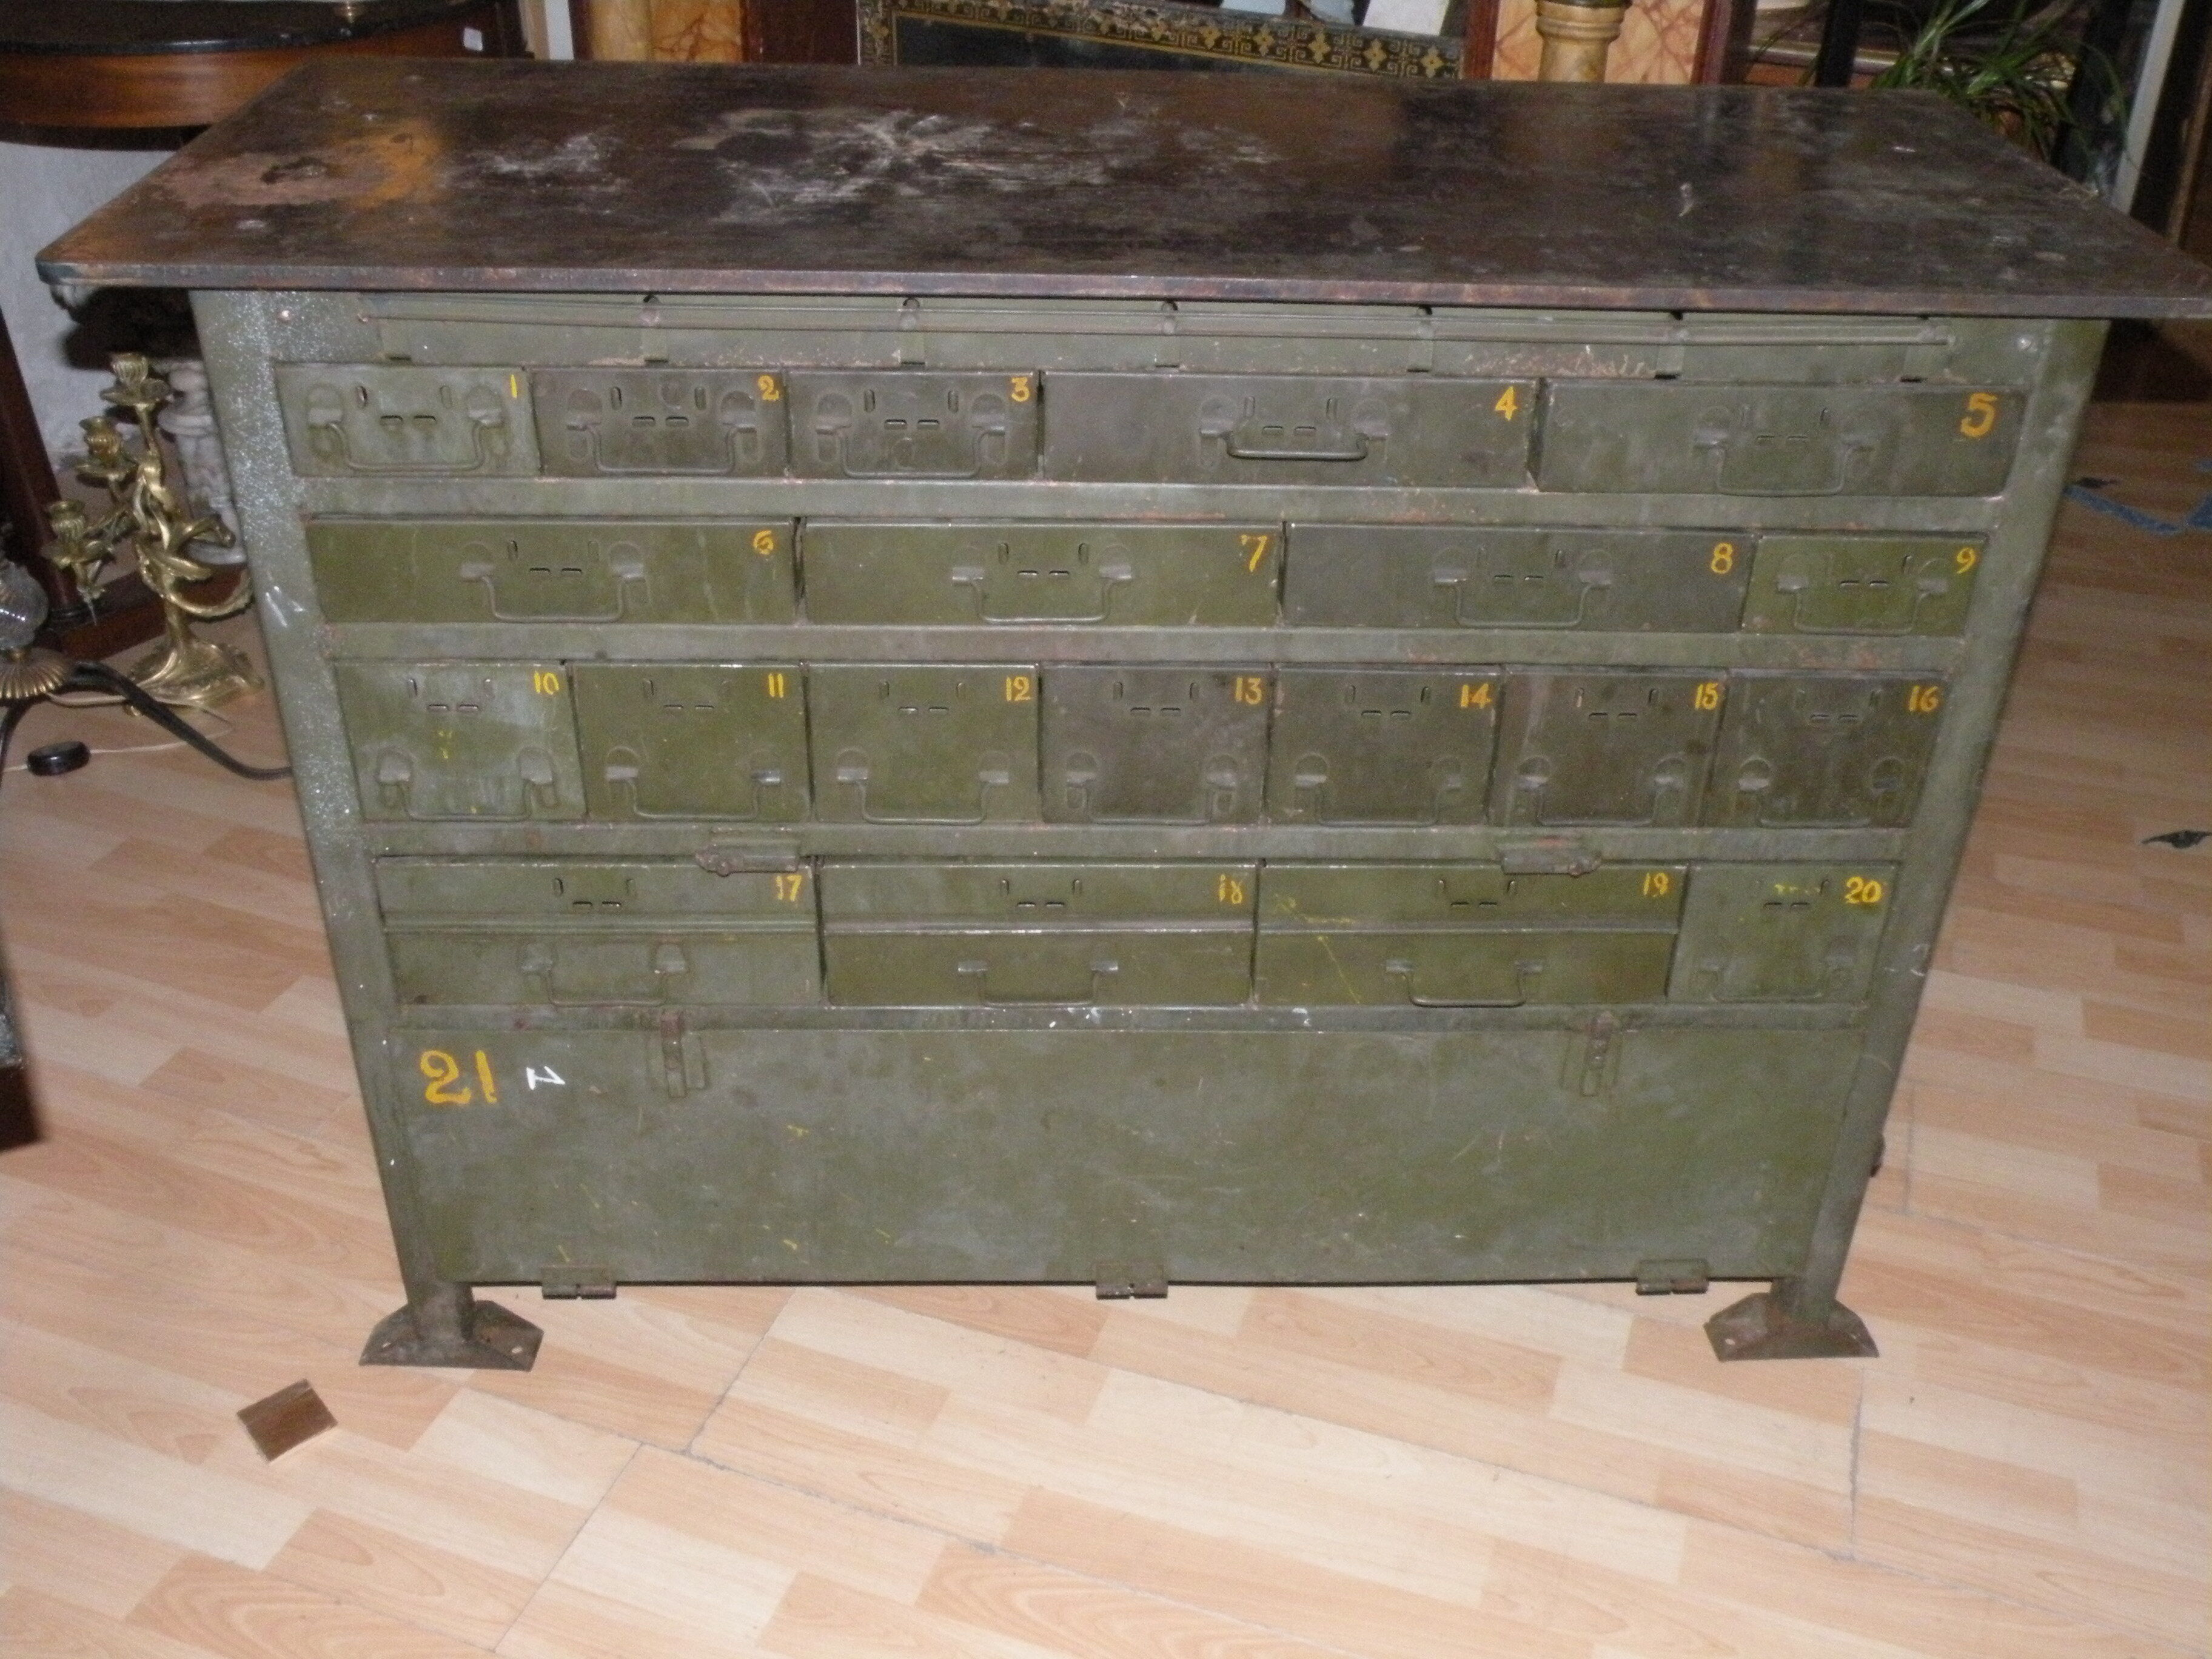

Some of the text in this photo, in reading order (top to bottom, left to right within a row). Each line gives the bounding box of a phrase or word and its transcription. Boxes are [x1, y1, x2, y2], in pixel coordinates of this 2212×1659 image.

[510, 374, 519, 399] 1
[758, 375, 781, 401] 2
[1010, 376, 1032, 402] 3
[1494, 387, 1520, 422] 4
[1960, 392, 1999, 438] 5
[751, 529, 778, 555] 6
[1239, 534, 1270, 572] 7
[1709, 541, 1735, 575] 8
[1955, 547, 1977, 575] 9
[532, 671, 563, 695] 10
[765, 672, 787, 699] 11
[1003, 675, 1033, 703] 12
[1233, 676, 1264, 705] 13
[1459, 683, 1493, 708] 14
[1693, 681, 1721, 711] 15
[1907, 685, 1939, 713] 16
[775, 873, 803, 903] 17
[1216, 875, 1246, 905] 18
[1641, 871, 1671, 899] 19
[1843, 875, 1886, 905] 20
[419, 1049, 500, 1106] 21
